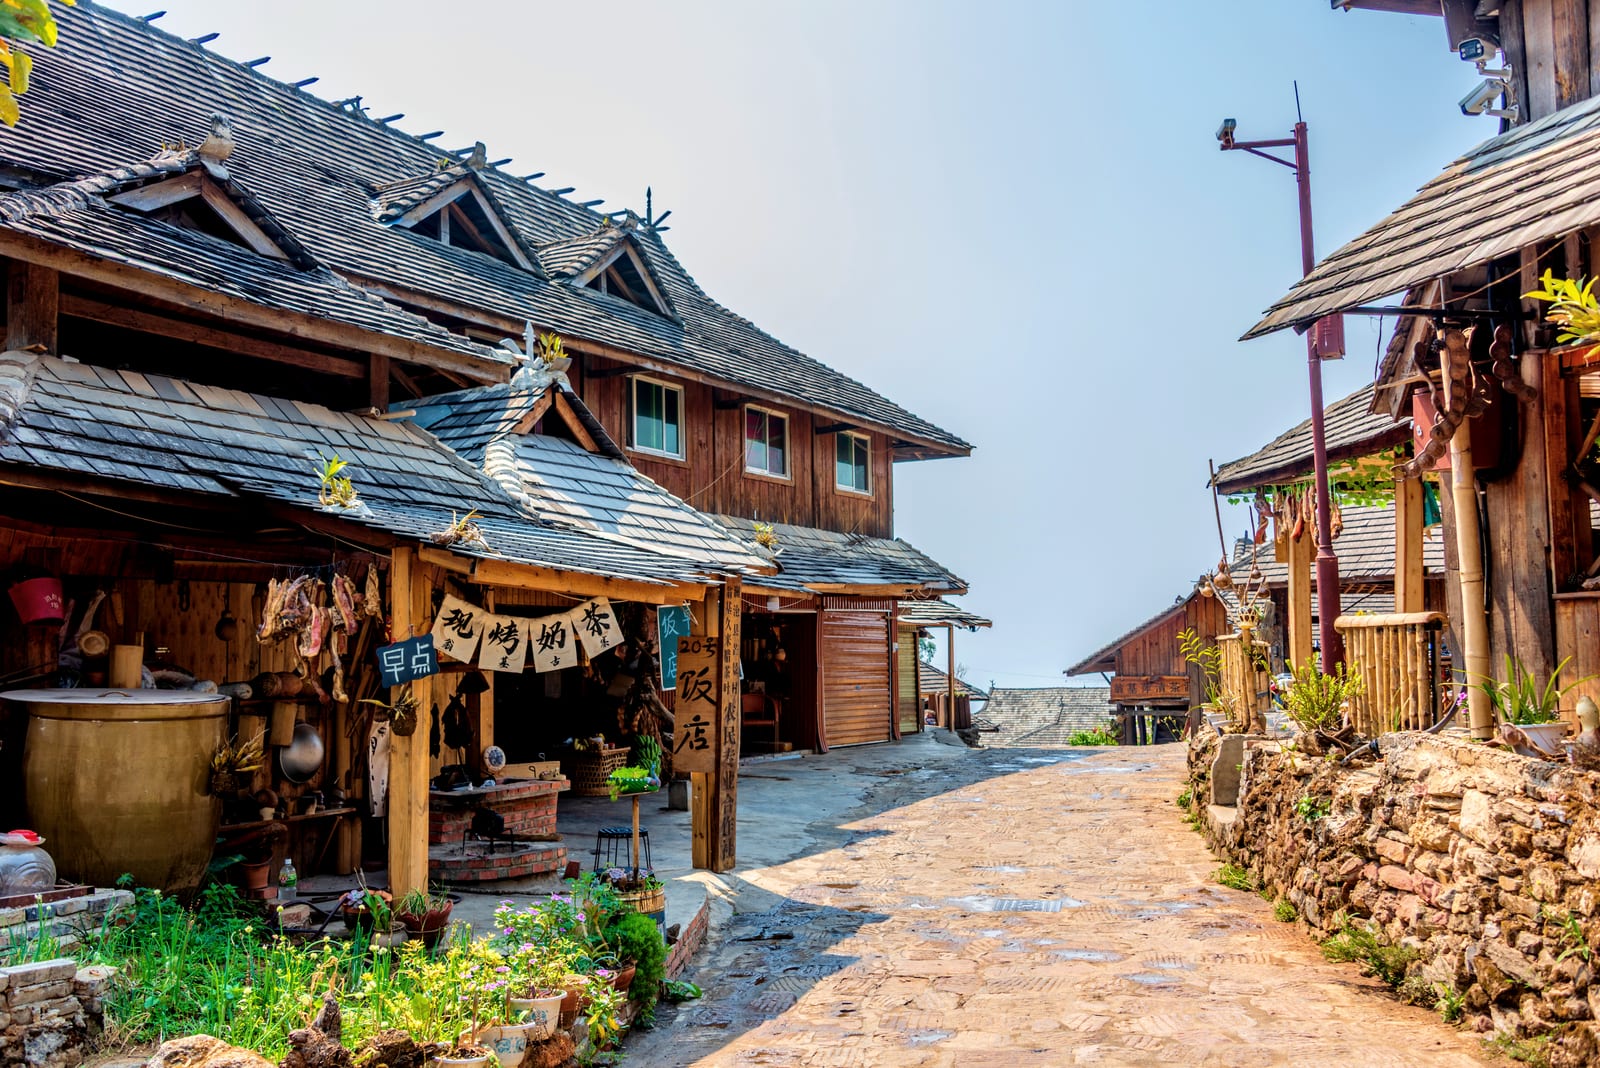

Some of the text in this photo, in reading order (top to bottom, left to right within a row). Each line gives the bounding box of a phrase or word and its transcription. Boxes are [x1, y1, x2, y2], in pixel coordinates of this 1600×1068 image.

[442, 602, 610, 655] 现烤奶茶
[679, 637, 717, 658] 20号
[382, 642, 431, 683] 早点
[674, 666, 717, 754] 饭店
